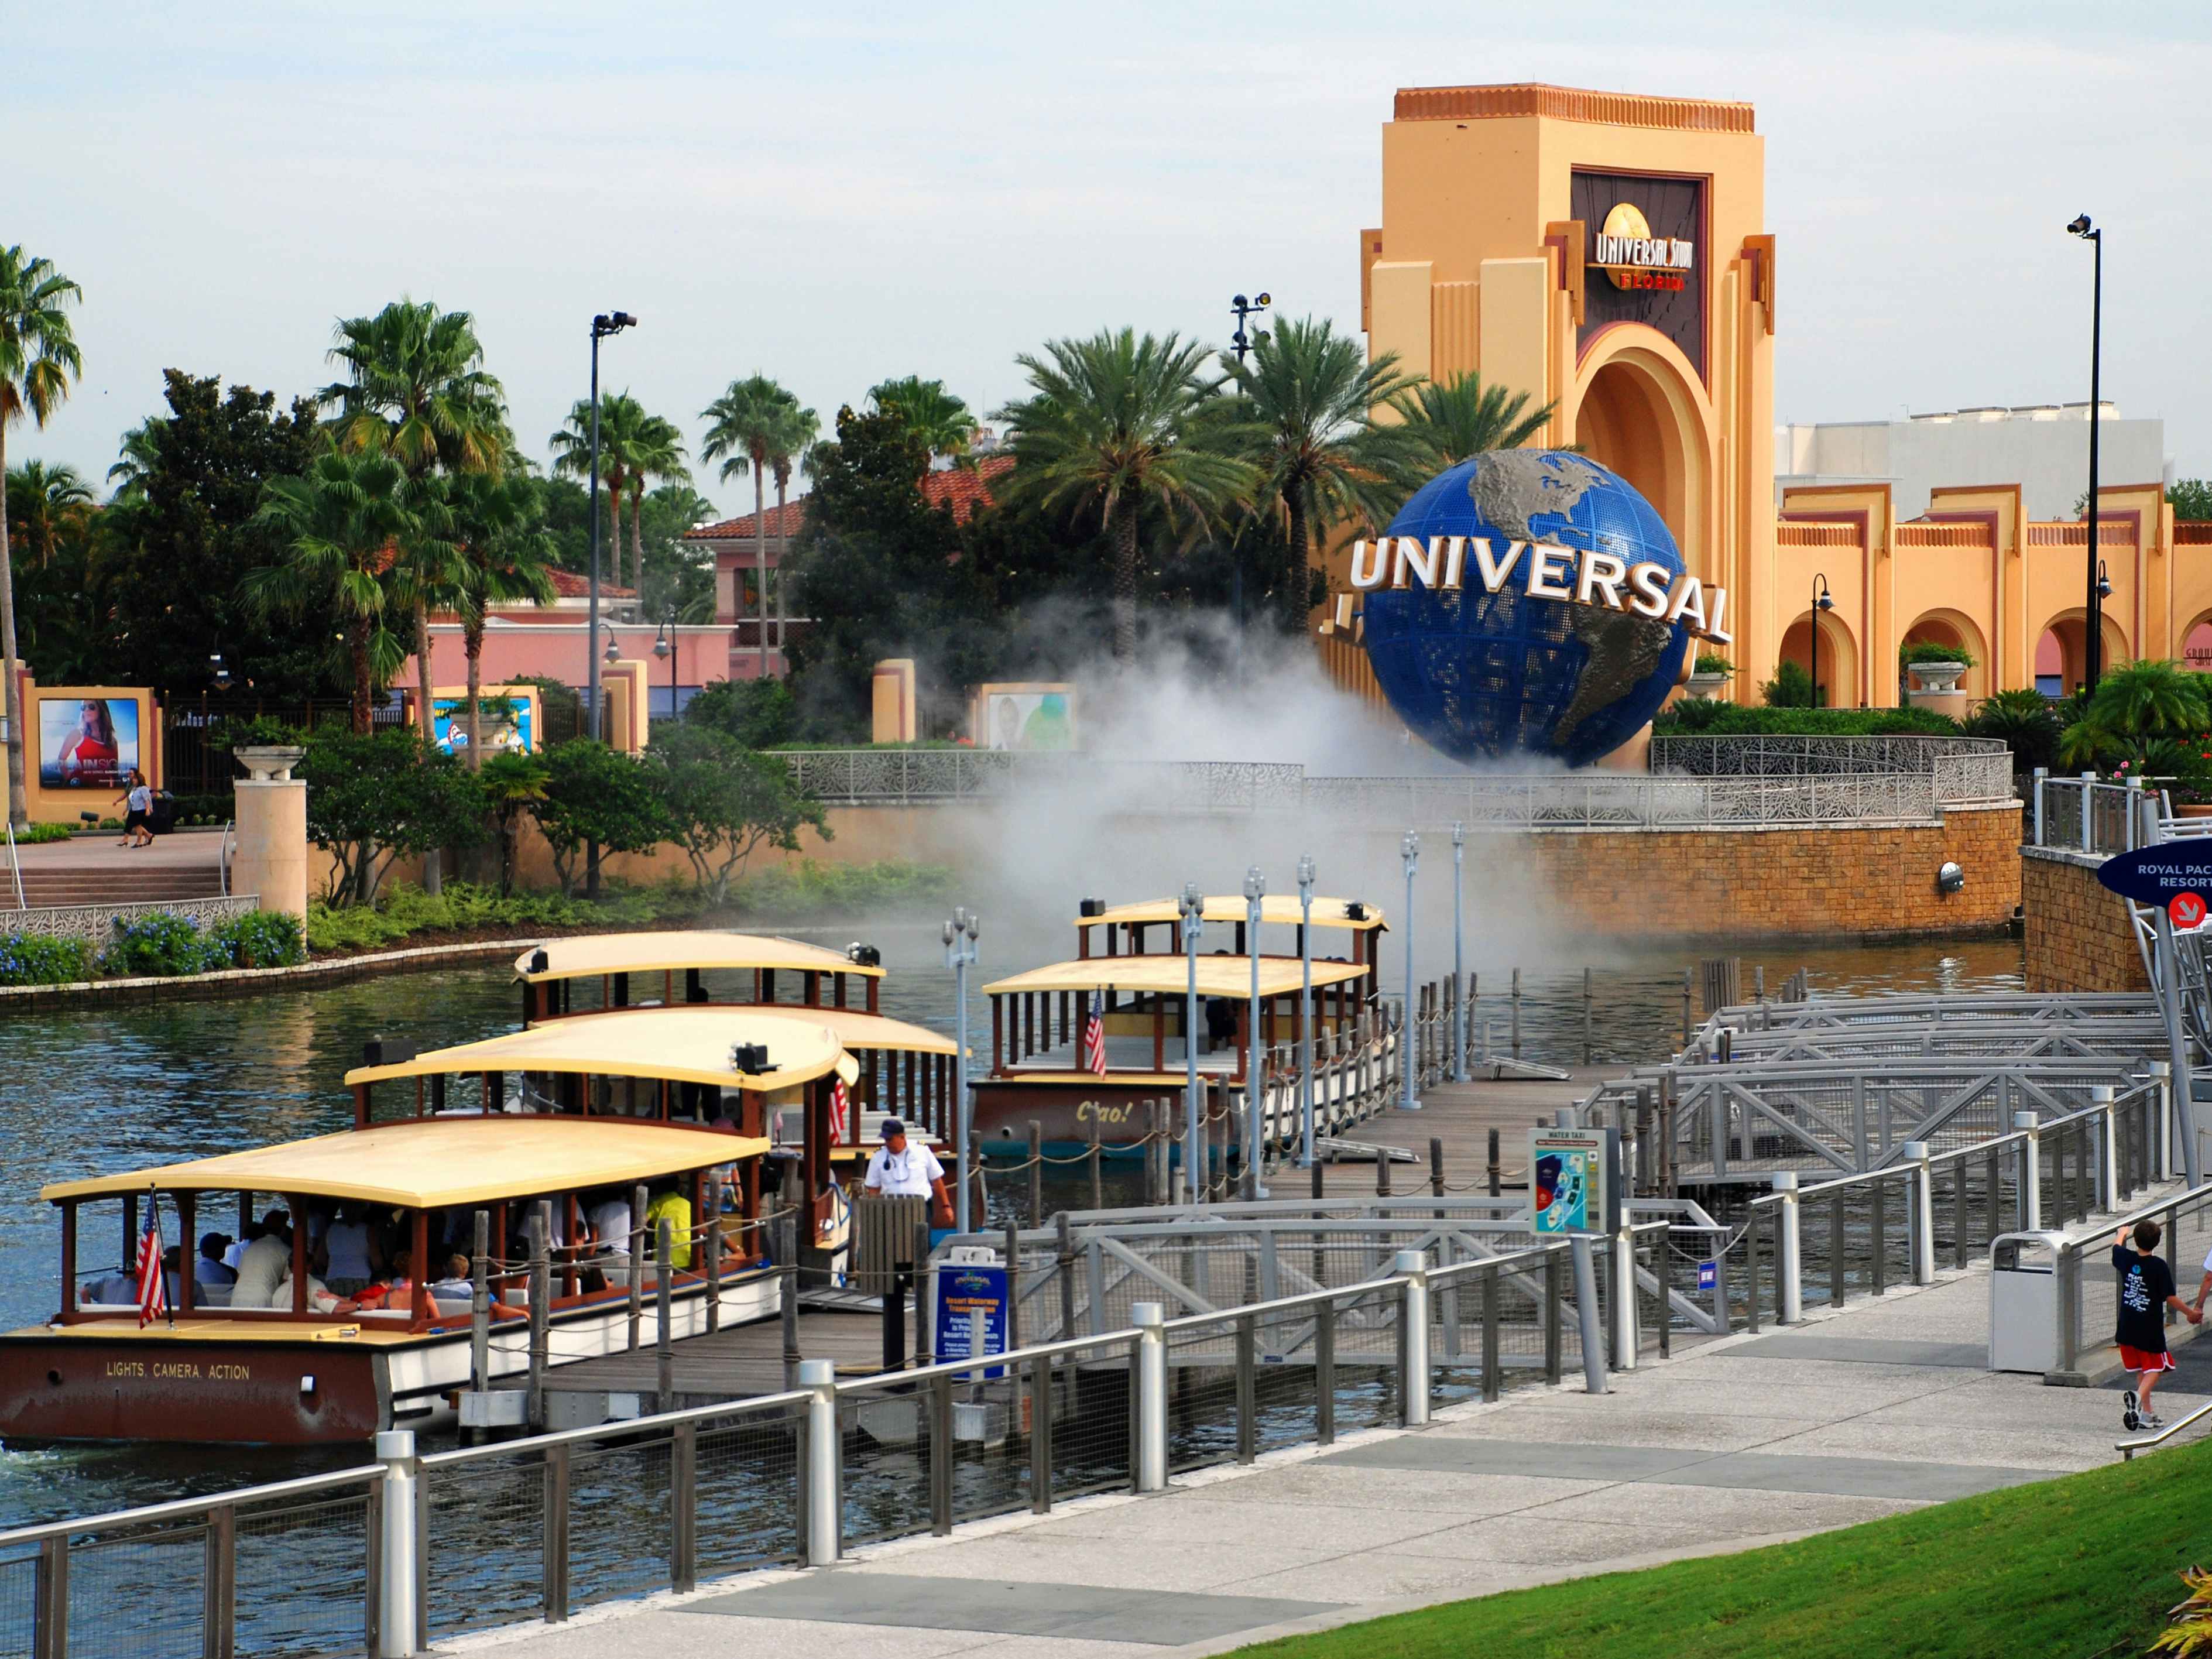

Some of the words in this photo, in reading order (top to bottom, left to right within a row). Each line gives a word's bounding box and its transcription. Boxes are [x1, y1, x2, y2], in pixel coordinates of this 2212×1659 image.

[1596, 233, 1668, 267] UNIVERSAL
[1350, 535, 1733, 645] UNIVERSAL
[2138, 865, 2183, 874] ROYAL
[2186, 865, 2212, 875] PAC
[1076, 1101, 1133, 1123] Ciao!
[208, 1365, 250, 1380] ACTION
